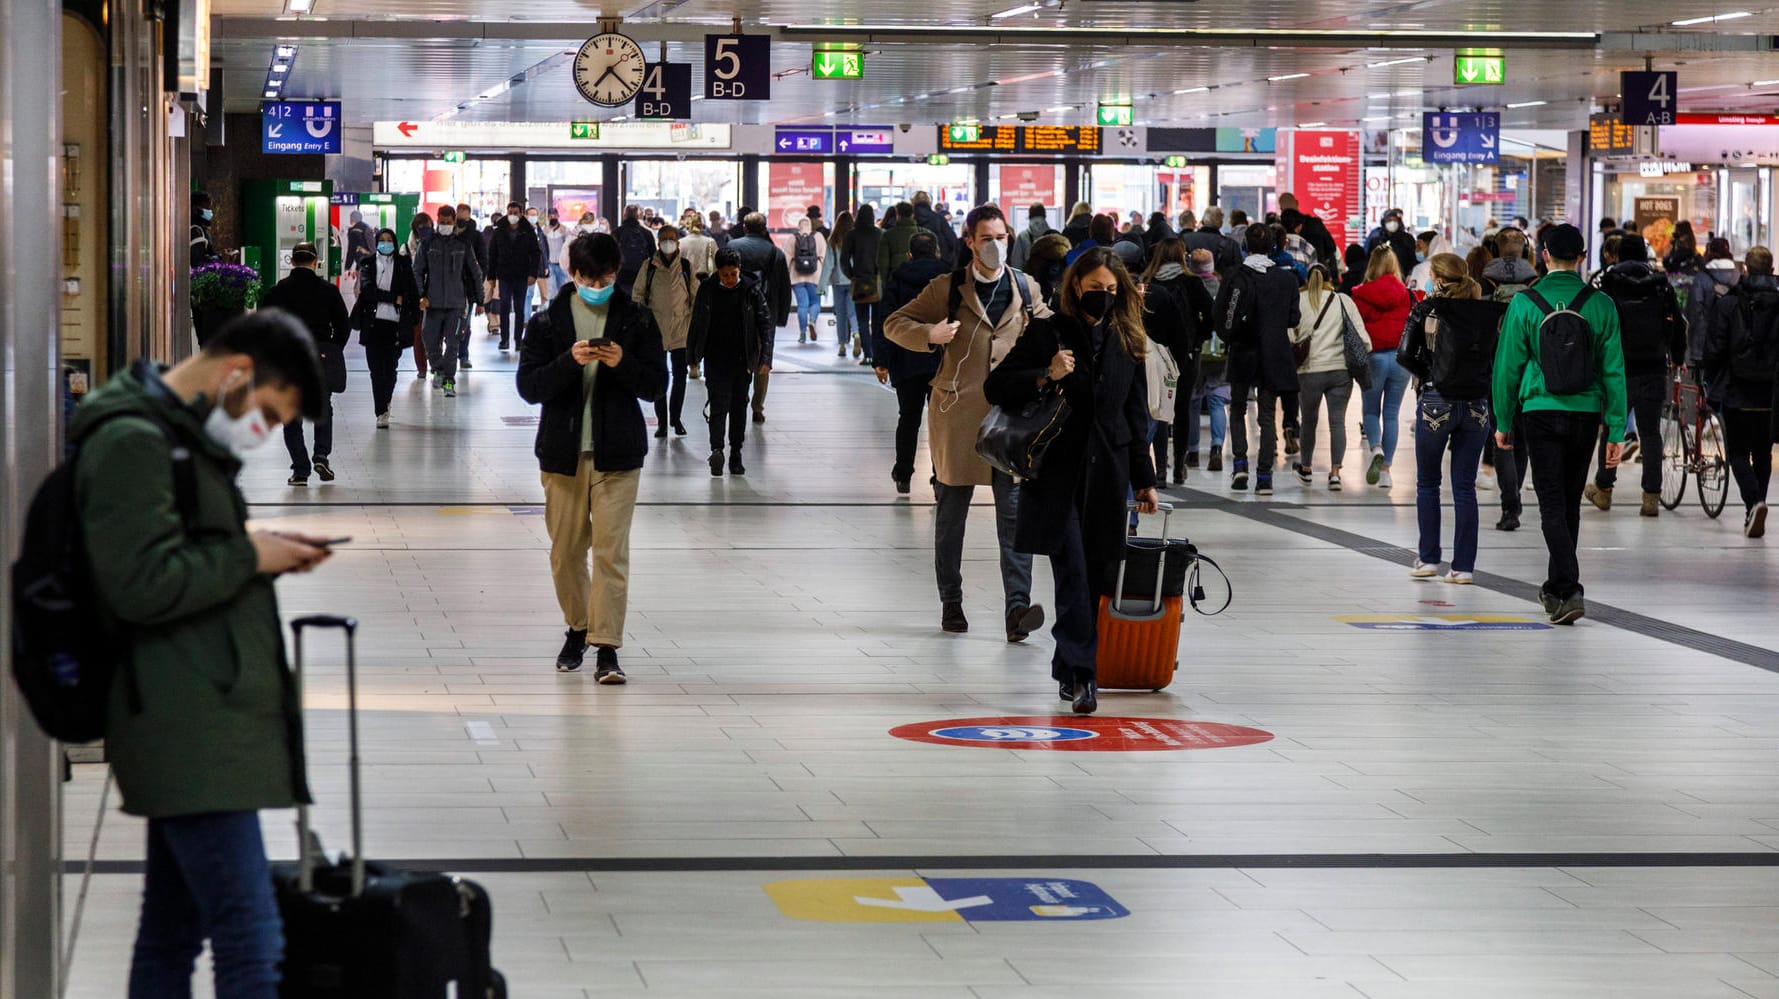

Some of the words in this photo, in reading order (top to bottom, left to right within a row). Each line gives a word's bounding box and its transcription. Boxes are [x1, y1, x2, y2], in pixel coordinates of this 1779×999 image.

[714, 38, 741, 80] 5
[643, 65, 666, 101] 4
[713, 82, 745, 97] B-D
[1648, 74, 1670, 109] 4
[643, 103, 671, 116] B-D
[1646, 112, 1671, 124] A-B
[268, 142, 302, 151] Eingang
[304, 143, 322, 151] Entry
[1434, 152, 1466, 161] Eingang
[282, 204, 304, 212] Tickets
